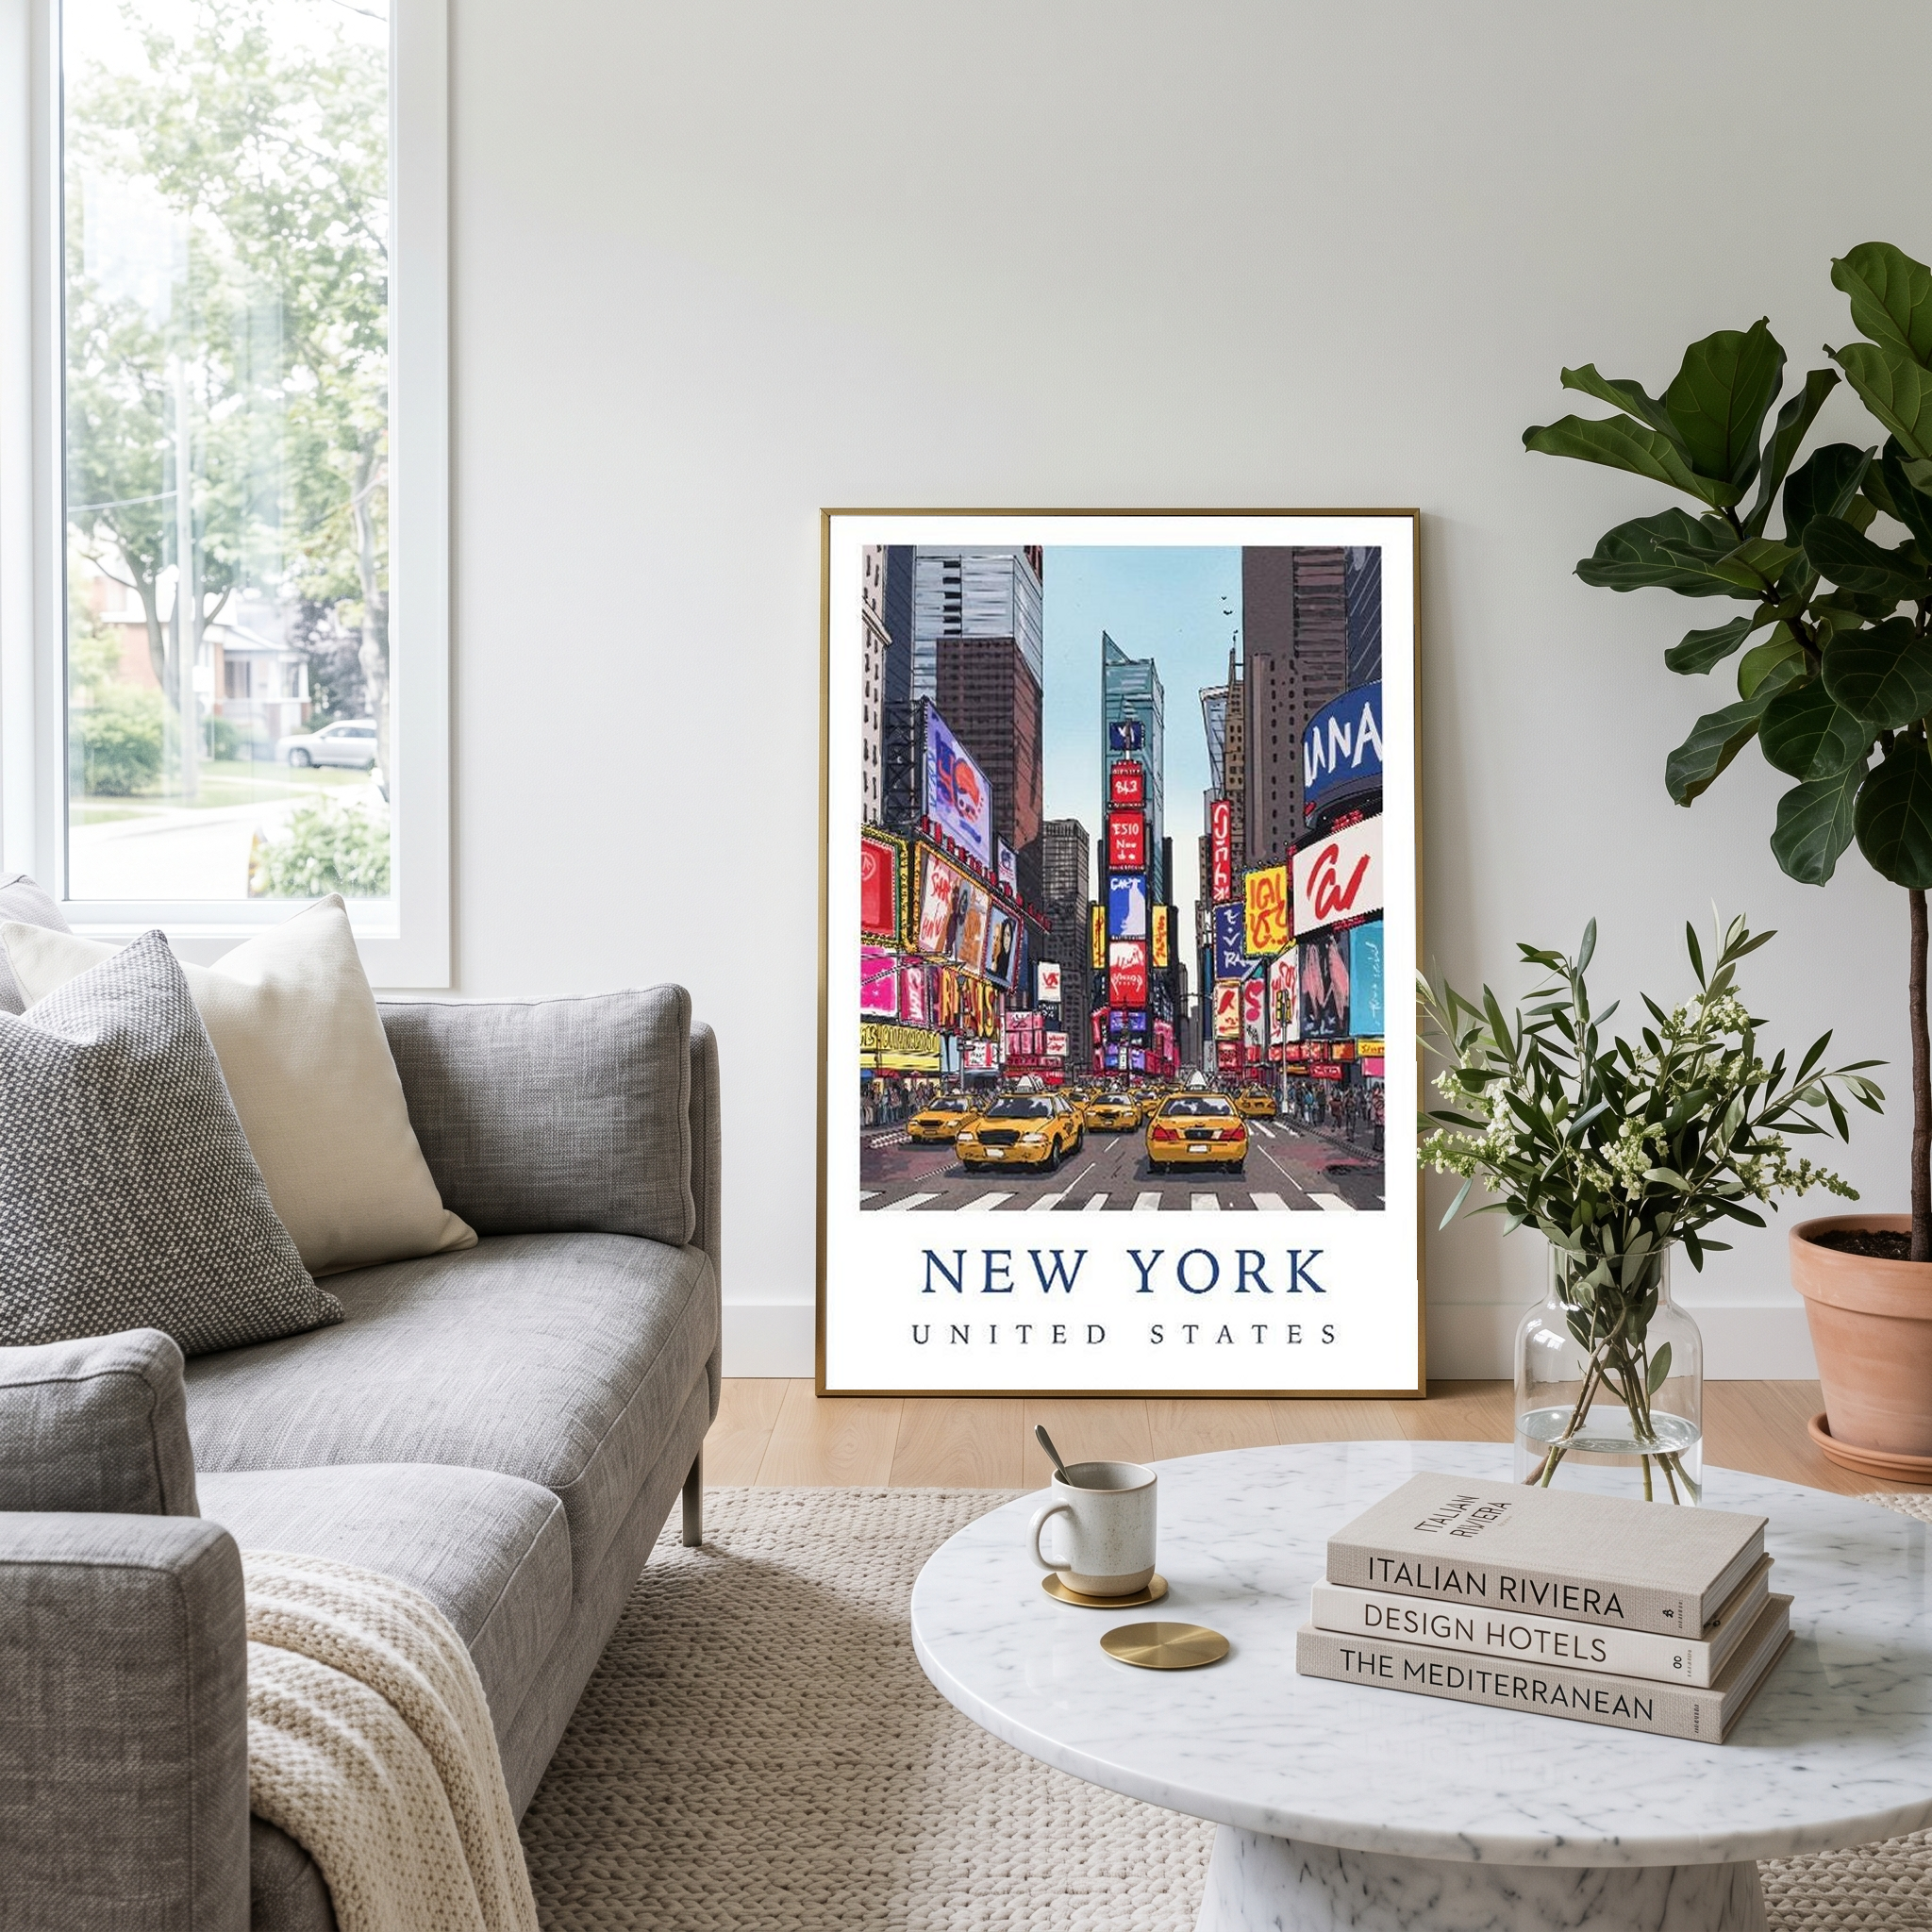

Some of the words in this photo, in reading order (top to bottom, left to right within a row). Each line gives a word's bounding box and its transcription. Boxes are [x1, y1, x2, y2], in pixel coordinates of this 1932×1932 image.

[922, 1249, 1088, 1294] NEW
[1126, 1248, 1326, 1295] YORK
[912, 1324, 1106, 1345] UNITED
[1150, 1324, 1335, 1345] STATES
[1414, 1494, 1480, 1533] ITALIAN
[1449, 1501, 1512, 1539] RIVIERA
[1369, 1557, 1486, 1597] ITALIAN
[1500, 1574, 1624, 1619] RIVIERA
[1365, 1604, 1474, 1642] DESIGN
[1487, 1621, 1607, 1663] HOTELS
[1340, 1648, 1394, 1678] THE
[1404, 1657, 1653, 1722] MEDITERRANEAN
